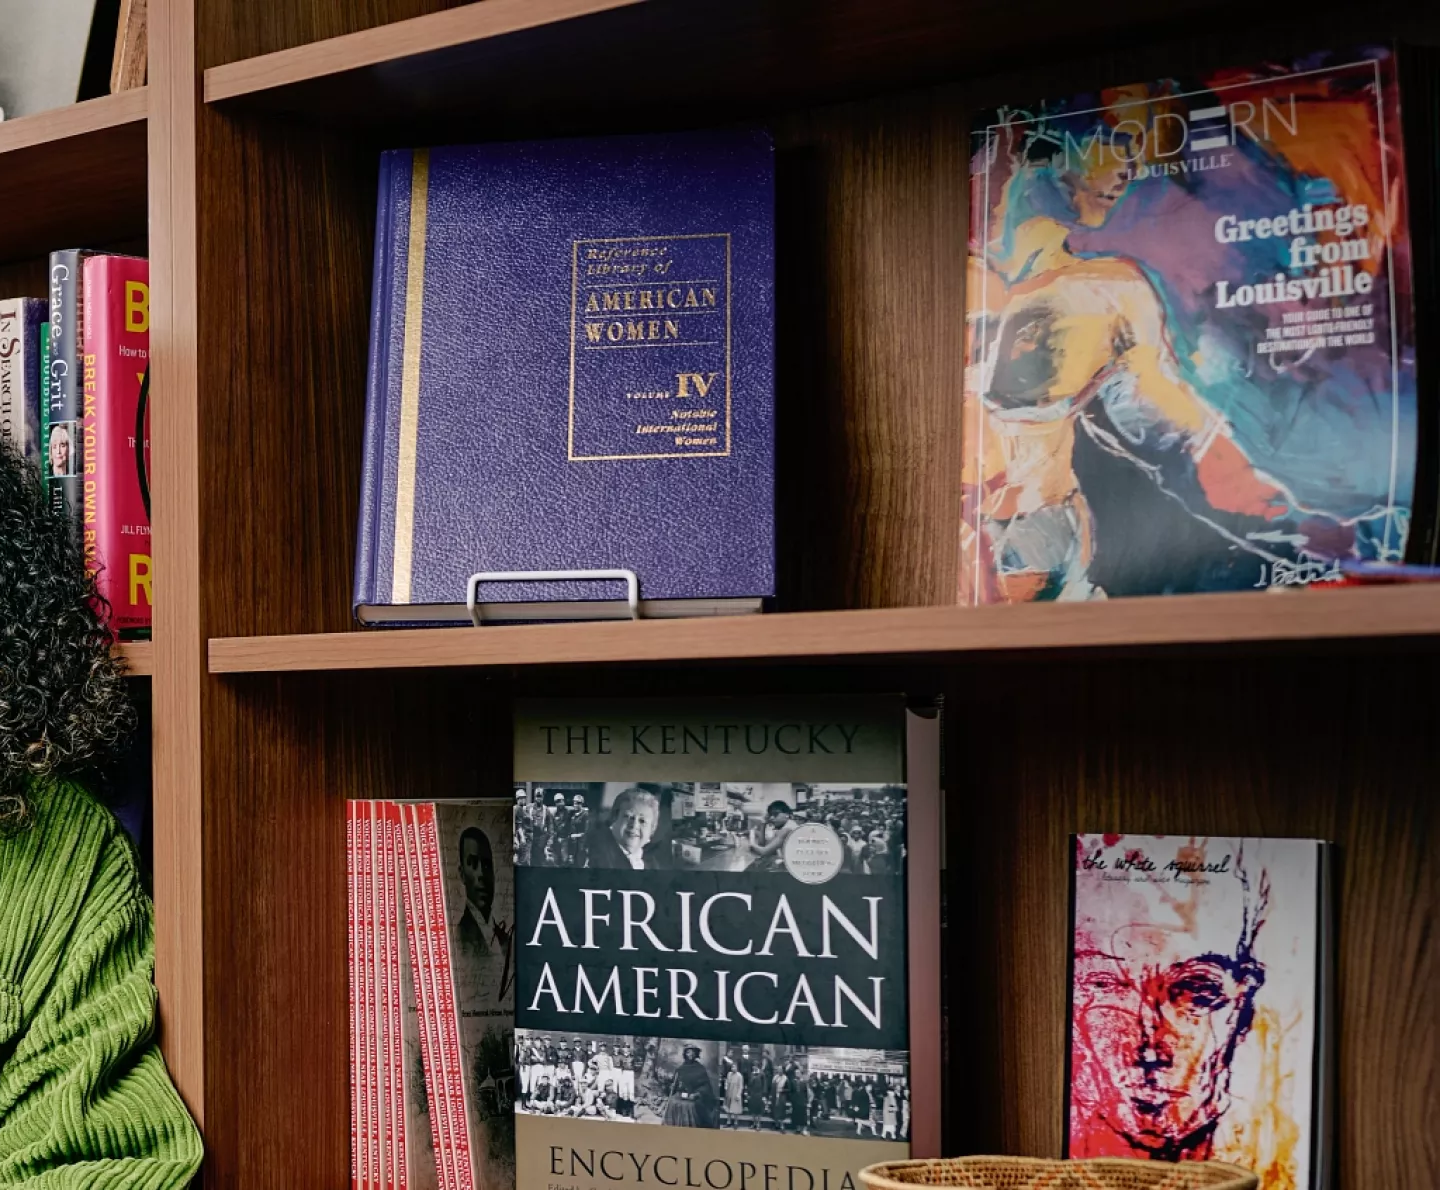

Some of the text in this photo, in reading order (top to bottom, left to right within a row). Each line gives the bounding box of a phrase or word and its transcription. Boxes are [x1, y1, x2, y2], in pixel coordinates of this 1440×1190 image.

[1065, 93, 1297, 170] MODERN
[1127, 154, 1232, 181] LOUISVILLE
[1214, 203, 1369, 244] Greetings
[586, 247, 667, 261] Reference
[587, 259, 673, 276] Library of
[1289, 236, 1370, 268] from
[51, 264, 69, 339] Grace
[585, 287, 718, 312] AMERICAN
[1215, 264, 1373, 308] Louisville
[1282, 311, 1304, 324] YOUR
[1332, 307, 1343, 319] TO
[1344, 305, 1360, 318] ONE
[1361, 304, 1374, 316] OF
[585, 320, 680, 342] WOMEN
[1266, 327, 1282, 340] THE
[1282, 325, 1306, 337] MOST
[1327, 335, 1344, 347] THE
[1345, 331, 1375, 346] WORLD
[119, 344, 147, 358] How to
[51, 359, 69, 411] Grit
[84, 354, 97, 417] BREAK
[626, 372, 720, 399] VOLUME IV
[636, 422, 718, 434] International
[670, 409, 718, 420] Notable
[84, 422, 97, 475] YOUR
[674, 436, 718, 447] Women
[84, 481, 97, 523] OWN
[120, 525, 135, 535] JILL
[539, 724, 860, 755] THE KENTUCKY
[375, 819, 383, 848] VOICES
[385, 819, 393, 848] VOICES
[394, 823, 404, 852] VOICES
[407, 823, 417, 852] VOICES
[419, 823, 429, 852] VOICES
[427, 822, 436, 851] VOICES
[376, 850, 384, 872] FROM
[398, 854, 406, 876] FROM
[411, 854, 420, 876] FROM
[422, 854, 431, 877] FROM
[430, 853, 439, 876] FROM
[1082, 849, 1231, 880] the white squirrel
[525, 886, 883, 960] AFRICAN
[379, 925, 387, 960] AFRICAN
[390, 926, 398, 960] AFRICAN
[407, 930, 418, 964] AFRICAN
[420, 930, 430, 964] AFRICAN
[431, 930, 441, 964] AFRICAN
[438, 930, 448, 964] AFRICAN
[358, 960, 366, 1001] AMERICAN
[380, 961, 388, 1003] AMERICAN
[391, 962, 399, 1004] AMERICAN
[412, 967, 424, 1009] AMERICAN
[424, 967, 435, 1009] AMERICAN
[435, 967, 446, 1009] AMERICAN
[442, 967, 453, 1010] AMERICAN
[526, 962, 885, 1030] AMERICAN
[549, 1145, 856, 1190] ENCYCLOPEDIA
